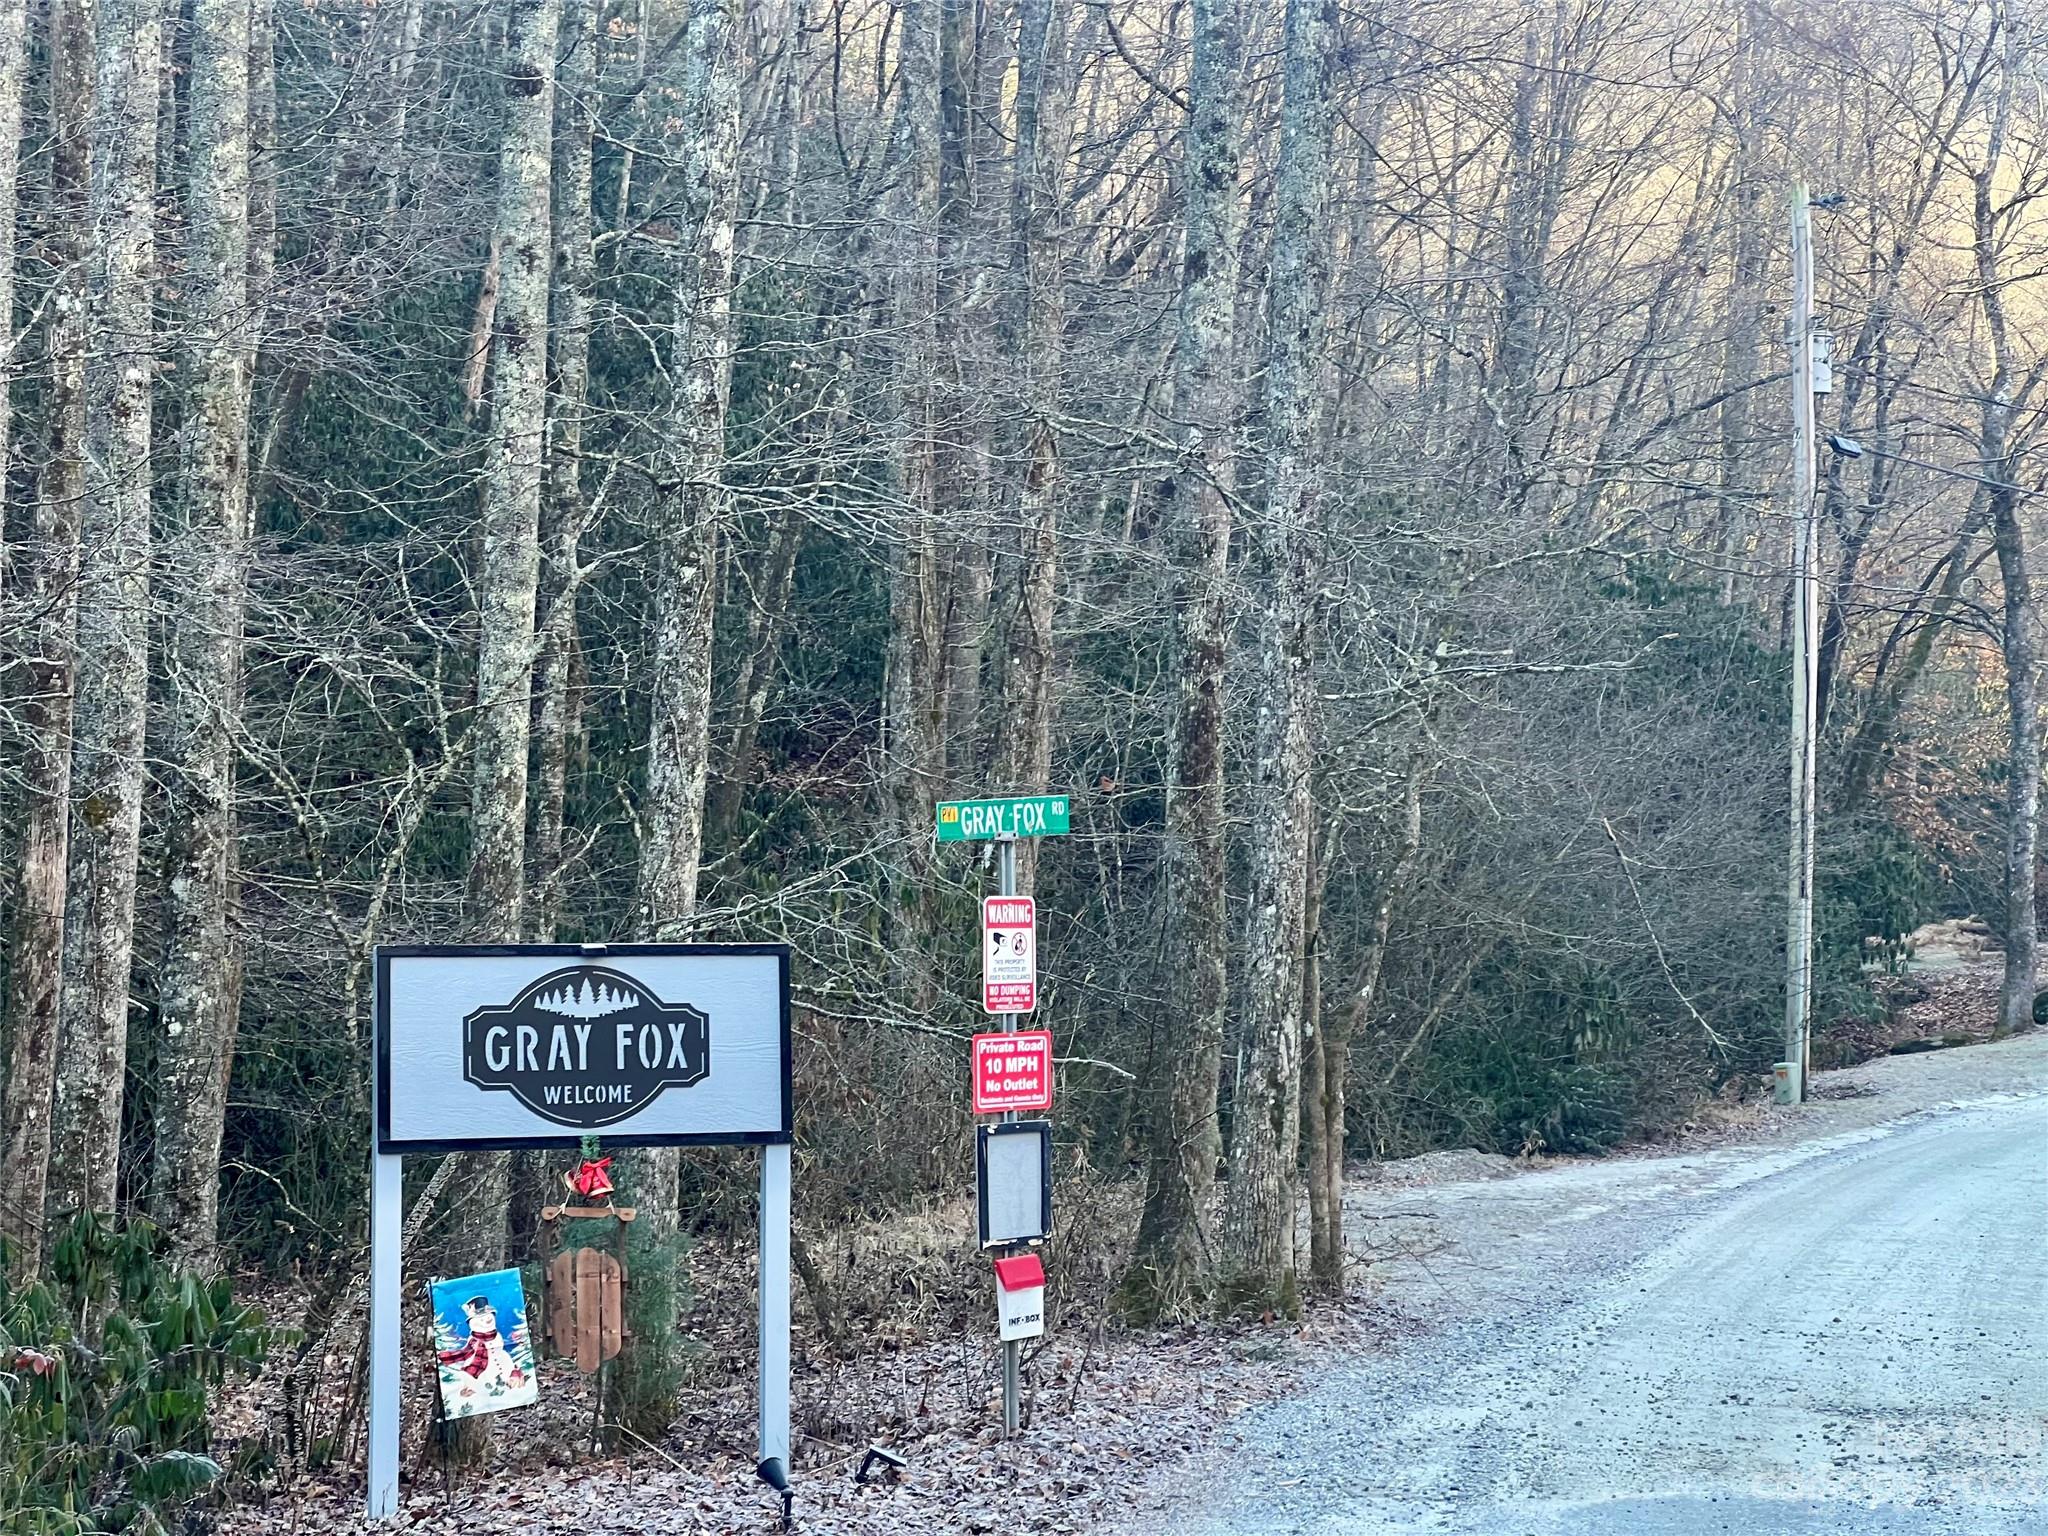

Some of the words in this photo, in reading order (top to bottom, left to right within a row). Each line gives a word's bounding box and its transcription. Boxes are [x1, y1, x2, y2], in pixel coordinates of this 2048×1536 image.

[961, 804, 1005, 835] GRAY
[1013, 802, 1046, 834] FOX
[1051, 801, 1065, 815] RD
[988, 904, 1031, 923] WARNING
[989, 985, 999, 996] NO
[1000, 984, 1031, 996] DUMPING
[484, 1024, 592, 1072] GRAY
[616, 1023, 688, 1070] FOX
[980, 1041, 1015, 1054] Private
[1017, 1040, 1044, 1052] Road
[985, 1058, 1002, 1074] 10
[1005, 1056, 1038, 1073] MPH
[543, 1084, 633, 1105] WELCOME
[986, 1080, 1001, 1093] No
[1003, 1078, 1038, 1091] Outlet
